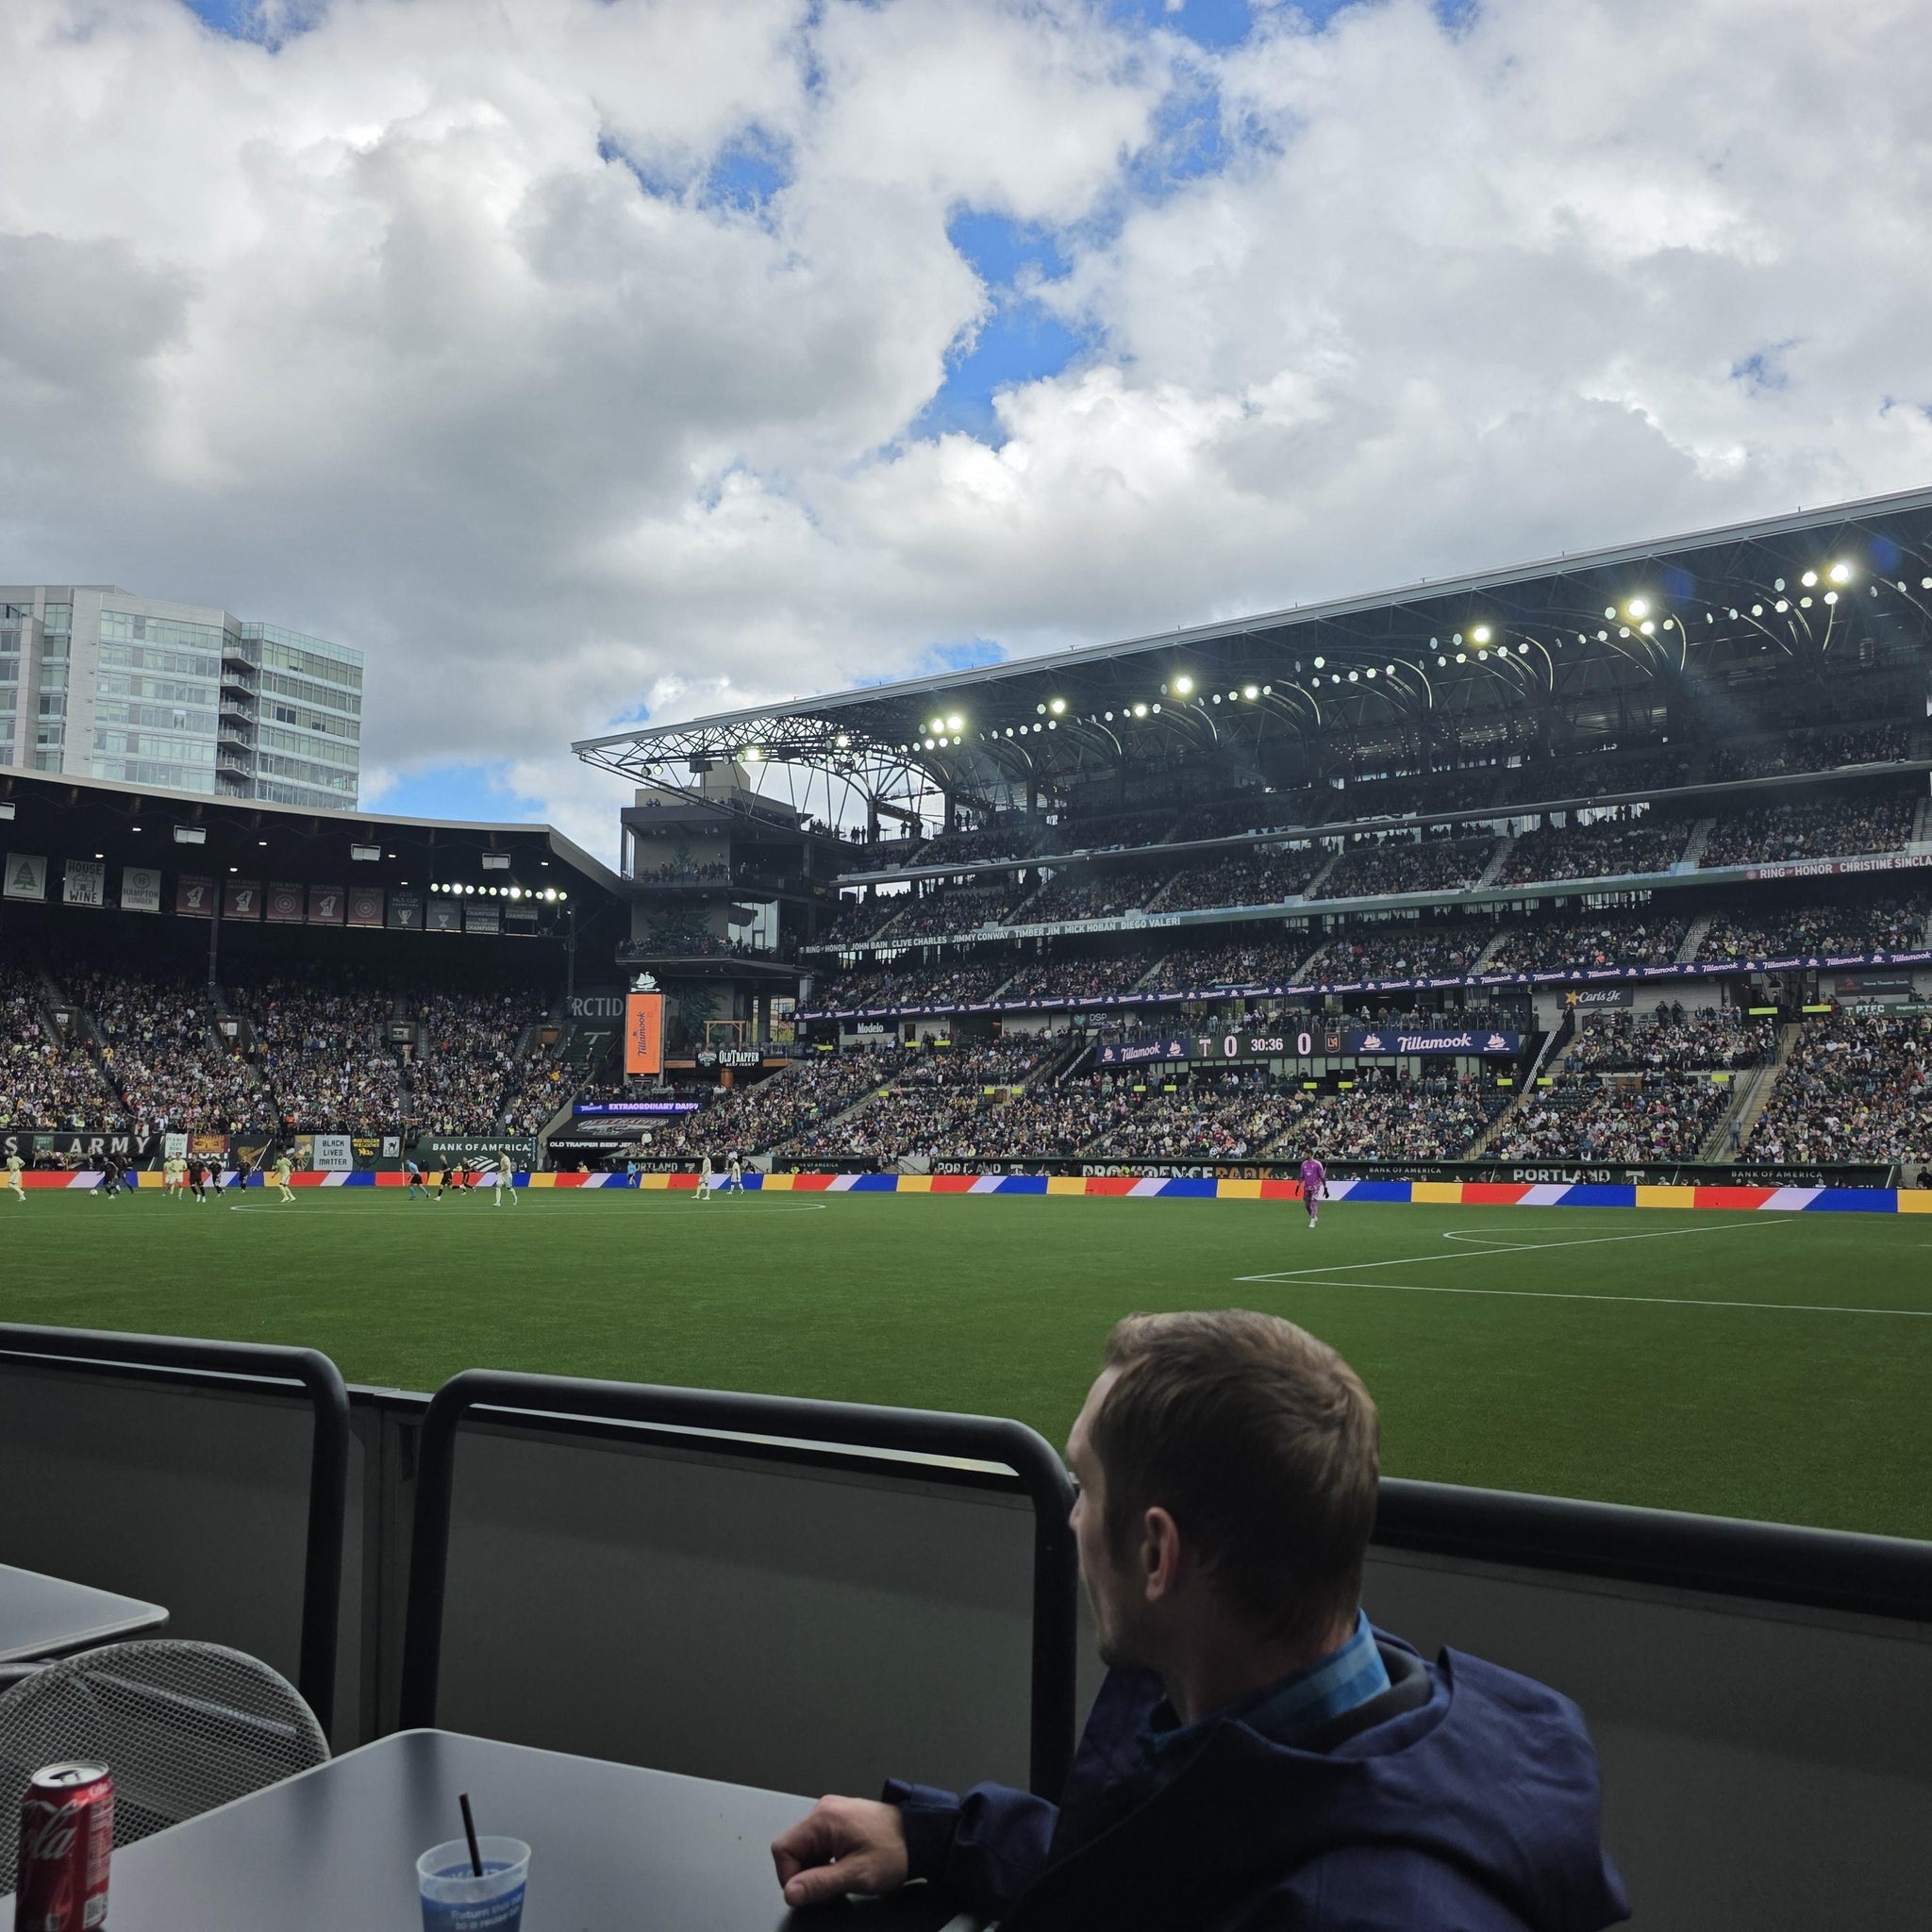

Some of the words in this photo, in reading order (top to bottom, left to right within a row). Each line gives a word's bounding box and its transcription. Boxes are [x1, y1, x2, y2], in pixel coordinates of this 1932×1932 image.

[68, 862, 102, 875] HOUSE
[1760, 868, 1785, 879] RING
[1795, 864, 1832, 877] HONOR
[1840, 859, 1893, 873] CHRISTINE
[70, 890, 98, 903] WINE
[123, 888, 158, 899] HAMPTON
[465, 923, 499, 932] CHAMPIONS
[825, 944, 846, 953] HONOR
[851, 942, 869, 951] JOHN
[871, 941, 888, 950] BAIN
[892, 939, 912, 948] CLIVE
[914, 936, 947, 946] CHARLES
[952, 933, 976, 943] JIMMY
[978, 931, 1009, 941] CONWAY
[1014, 928, 1044, 938] TIMBER
[1046, 927, 1060, 936] JIM
[1065, 925, 1085, 934] MICK
[1086, 922, 1116, 932] HOBAN
[1121, 919, 1147, 930] DIEGO
[1149, 917, 1180, 927] VALERI
[1199, 990, 1226, 999] Tillamook
[1243, 988, 1269, 997] Tillamook
[1287, 986, 1316, 994] Tillamook
[1333, 983, 1362, 992] Tillamook
[1381, 980, 1411, 990] Tillamook
[1430, 977, 1460, 987] Tillamook
[1480, 974, 1512, 984] Tillamook
[1533, 971, 1566, 981] Tillamook
[1587, 968, 1621, 979] Tillamook
[1643, 965, 1679, 976] Tillamook
[1701, 962, 1738, 973] Tillamook
[1762, 959, 1801, 970] Tillamook
[1825, 955, 1865, 966] Tillamook
[1890, 951, 1932, 963] Tillamook
[1606, 990, 1621, 1002] Jr.
[573, 998, 623, 1016] RCTID
[1856, 1004, 1885, 1014] PTFC
[1089, 1013, 1107, 1021] DSP
[637, 1011, 647, 1057] Tillamook
[857, 1022, 884, 1034] Modelo
[1224, 1035, 1237, 1057] 0
[1251, 1038, 1283, 1052] 30:36
[1297, 1033, 1311, 1055] 0
[1397, 1033, 1472, 1052] Tillamook
[719, 1050, 731, 1064] OLD
[731, 1050, 759, 1064] TRAPPER
[1121, 1042, 1161, 1062] Tillamook
[70, 1137, 150, 1154] ARMY
[635, 1162, 678, 1171] ORTLAND
[938, 1163, 1001, 1173] PORTAND
[1215, 1167, 1274, 1179] PARK
[1514, 1170, 1611, 1182] PORTLAND
[452, 1908, 490, 1919] Return
